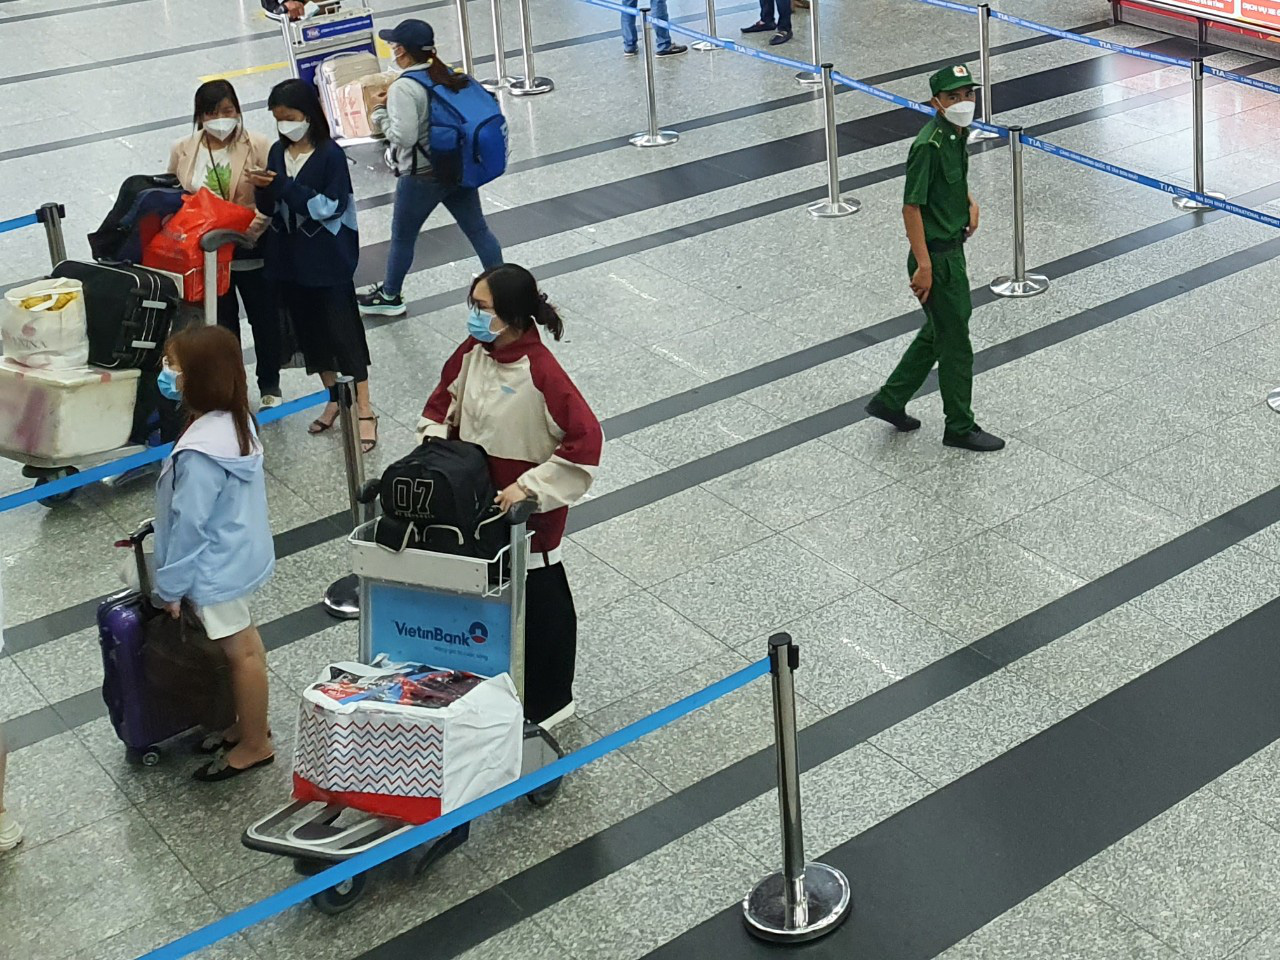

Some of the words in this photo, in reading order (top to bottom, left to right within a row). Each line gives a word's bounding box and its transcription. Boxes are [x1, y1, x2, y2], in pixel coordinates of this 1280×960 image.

[997, 12, 1009, 21] TIA
[1098, 41, 1112, 50] TIA
[1211, 68, 1225, 78] TIA
[1028, 138, 1042, 148] TIA
[1159, 183, 1175, 194] TIA
[393, 477, 433, 514] 07
[394, 620, 470, 647] VietinBank
